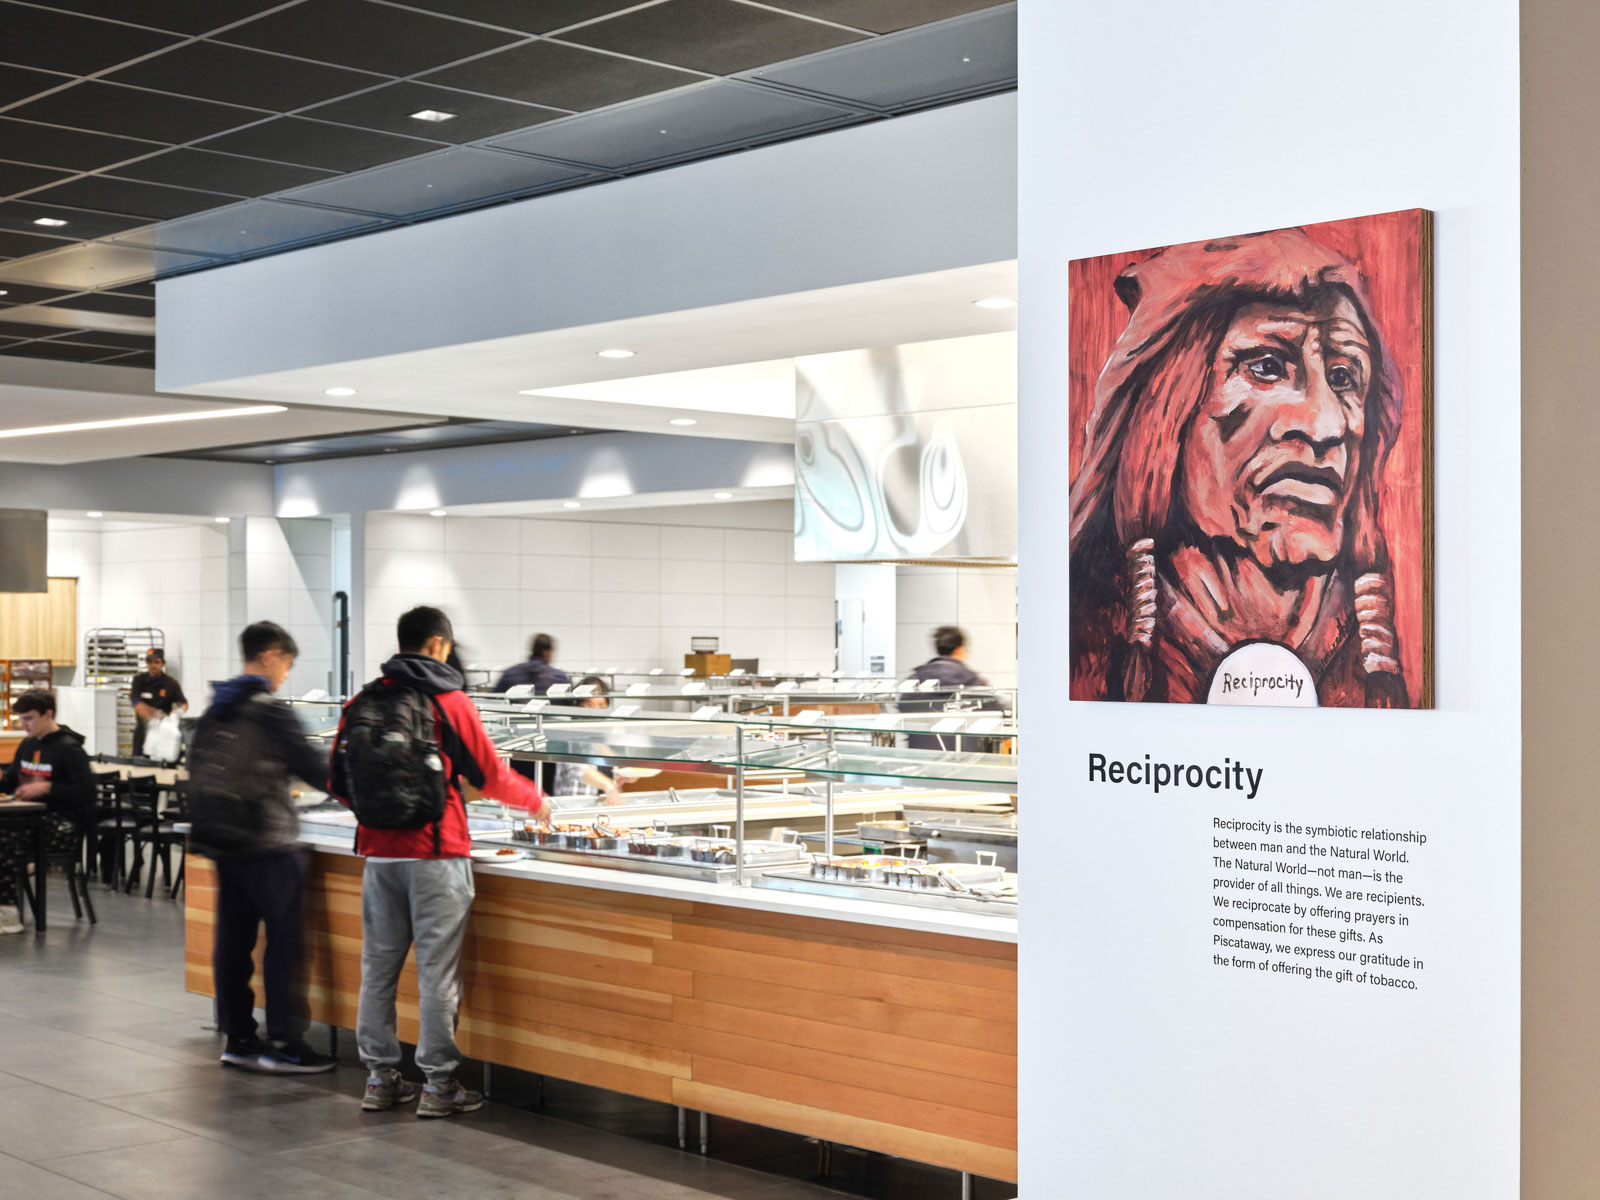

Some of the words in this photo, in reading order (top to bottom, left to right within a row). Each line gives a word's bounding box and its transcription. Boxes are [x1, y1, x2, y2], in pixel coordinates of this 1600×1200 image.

[1222, 672, 1304, 698] Reciprocity
[1089, 753, 1263, 800] Reciprocity
[1213, 817, 1271, 835] Reciprocity
[1274, 821, 1282, 833] is
[1285, 822, 1302, 834] the
[1305, 825, 1358, 838] symbiotic
[1361, 828, 1427, 846] relationship
[1213, 836, 1257, 851] between
[1260, 843, 1283, 853] man
[1286, 843, 1306, 855] and
[1309, 844, 1327, 856] the
[1330, 846, 1370, 860] Natural
[1373, 849, 1409, 863] World.
[1212, 856, 1232, 869] The
[1235, 858, 1272, 872] Natural
[1275, 861, 1335, 878] World—not
[1338, 869, 1382, 882] man—is
[1385, 870, 1403, 884] the
[1213, 877, 1255, 890] provider
[1258, 880, 1268, 891] of
[1270, 881, 1283, 893] all
[1285, 882, 1322, 899] things.
[1325, 886, 1342, 899] We
[1345, 891, 1363, 901] are
[1366, 891, 1424, 907] recipients.
[1213, 895, 1229, 908] We
[1232, 898, 1291, 914] reciprocate
[1294, 903, 1307, 918] by
[1310, 905, 1351, 923] offering
[1354, 912, 1396, 926] prayers
[1399, 913, 1409, 926] in
[1213, 917, 1286, 933] compensation
[1289, 922, 1304, 935] for
[1306, 925, 1336, 939] these
[1339, 929, 1365, 943] gifts.
[1368, 932, 1383, 944] As
[1213, 934, 1273, 954] Piscataway,
[1275, 944, 1291, 954] we
[1294, 946, 1335, 959] express
[1338, 951, 1357, 962] our
[1360, 953, 1410, 968] gratitude
[1413, 957, 1423, 970] in
[1213, 954, 1229, 966] the
[1232, 955, 1256, 969] form
[1258, 960, 1269, 971] of
[1272, 961, 1312, 979] offering
[1315, 966, 1333, 979] the
[1335, 969, 1353, 983] gift
[1356, 971, 1367, 983] of
[1369, 973, 1418, 990] tobacco.
